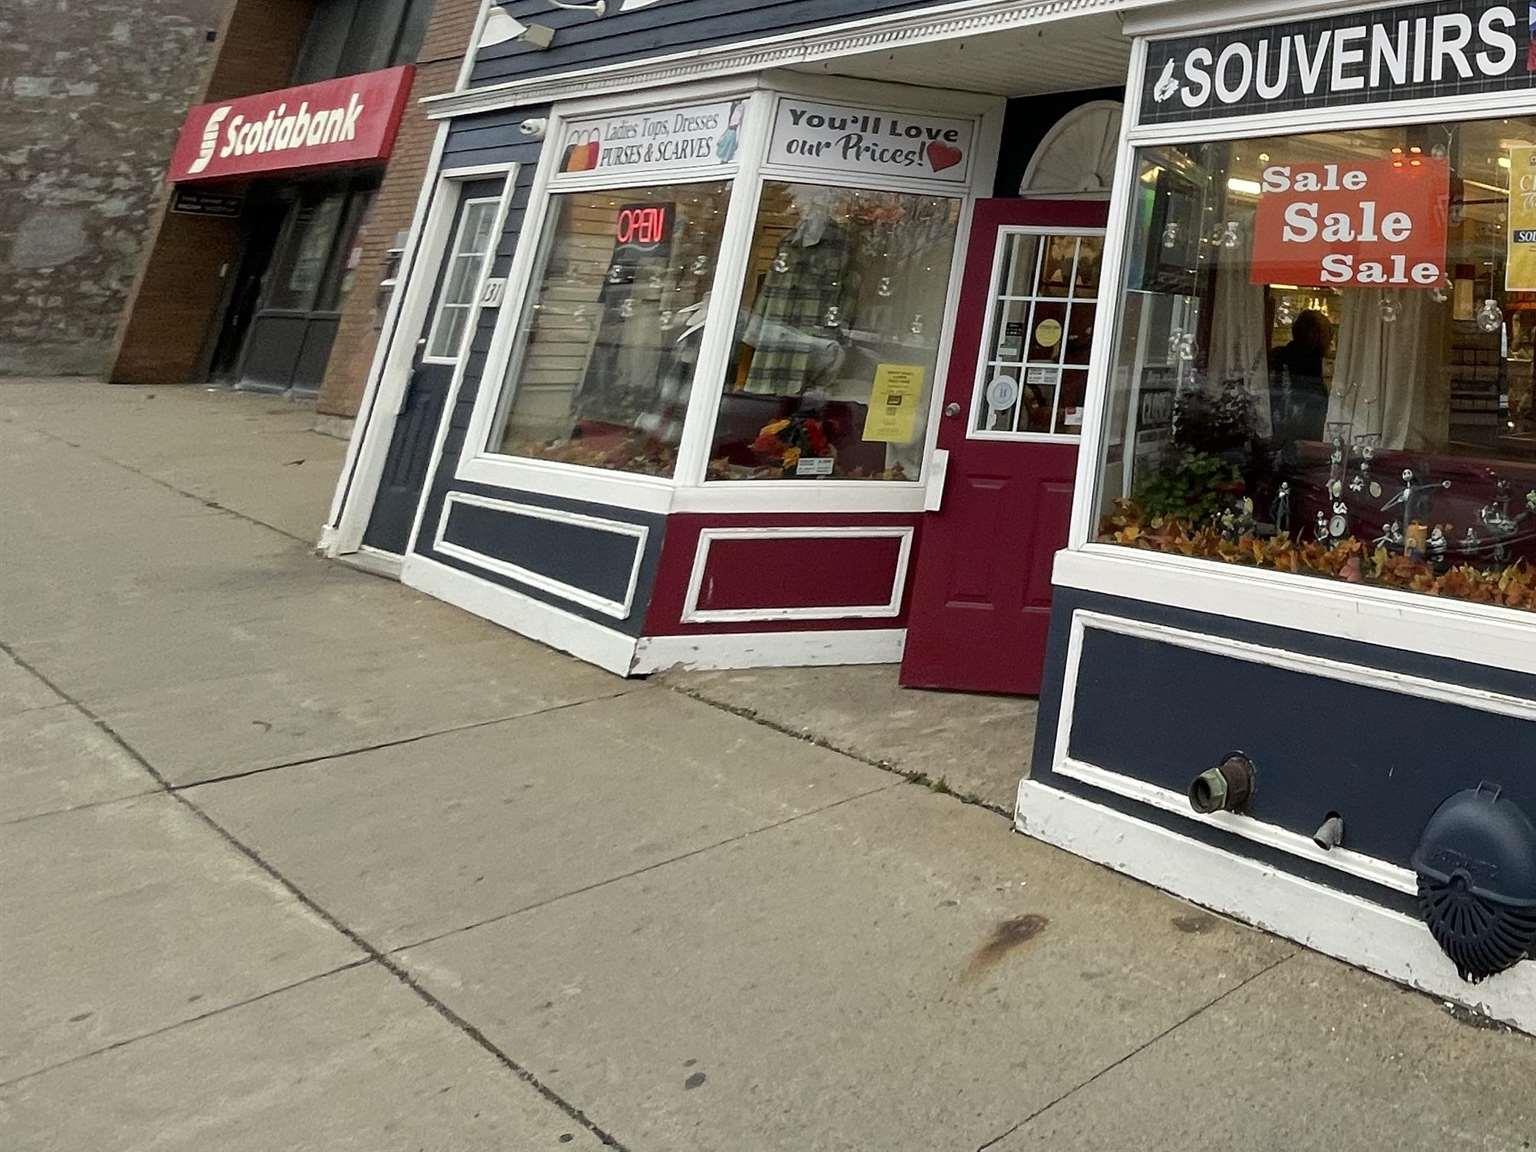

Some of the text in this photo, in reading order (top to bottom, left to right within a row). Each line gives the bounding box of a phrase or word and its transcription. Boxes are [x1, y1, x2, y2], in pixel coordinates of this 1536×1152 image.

[1180, 6, 1517, 108] SOUVENIRS
[220, 93, 365, 158] Scotiabank
[604, 113, 720, 141] Ladies Tops, Dresses
[789, 109, 959, 142] You'll Love
[600, 136, 713, 167] PURSES & SCARVES
[786, 132, 928, 167] our Prices!
[1262, 163, 1368, 194] Sale
[617, 208, 665, 243] OPEN
[1282, 201, 1412, 243] Sale
[1320, 254, 1440, 285] Sale
